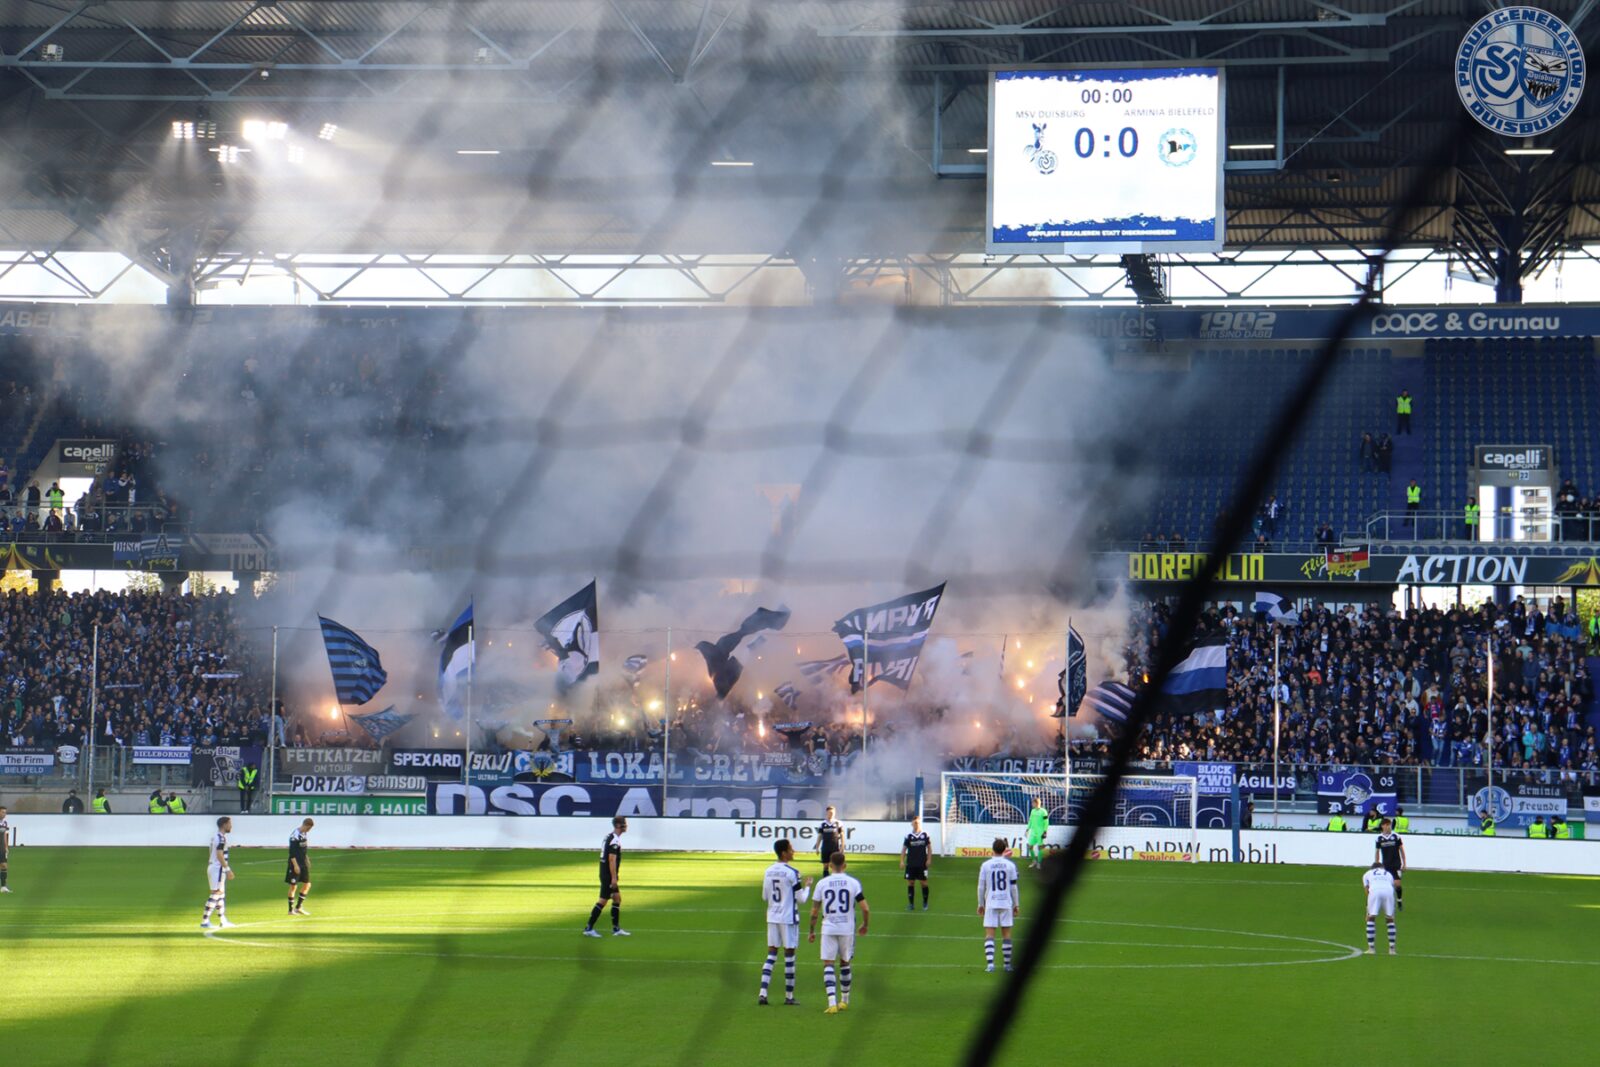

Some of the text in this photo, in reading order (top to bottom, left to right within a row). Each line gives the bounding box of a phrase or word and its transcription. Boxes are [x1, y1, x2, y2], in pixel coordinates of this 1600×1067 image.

[1015, 110, 1086, 119] MSV DUISBURG
[1124, 107, 1215, 118] ARMINIA BIELEFELD
[1074, 126, 1139, 159] 0:0
[1200, 312, 1277, 331] 1902
[1371, 312, 1560, 334] pape & Grunau
[64, 444, 114, 460] capelli
[1484, 449, 1540, 468] capelli
[1396, 555, 1528, 584] ACTION
[218, 746, 238, 756] Blue
[286, 749, 382, 763] FETTKATZEN
[6, 756, 44, 764] The Firm
[394, 753, 462, 767] SPEXARD
[588, 752, 772, 782] LOKAL CREW
[314, 764, 352, 772] ON TOUR
[1198, 765, 1232, 774] BLOCK
[292, 776, 345, 792] PORTA
[367, 776, 426, 790] SAMSON
[1198, 775, 1232, 786] ZWO
[1322, 776, 1394, 787] 19 05
[1518, 784, 1560, 796] Arminia
[436, 784, 592, 816] DSC
[1518, 801, 1560, 812] Freunde
[314, 803, 356, 814] HEIM
[364, 803, 374, 814] &
[992, 870, 1007, 892] 18
[772, 879, 782, 903] 5
[824, 888, 850, 914] 29
